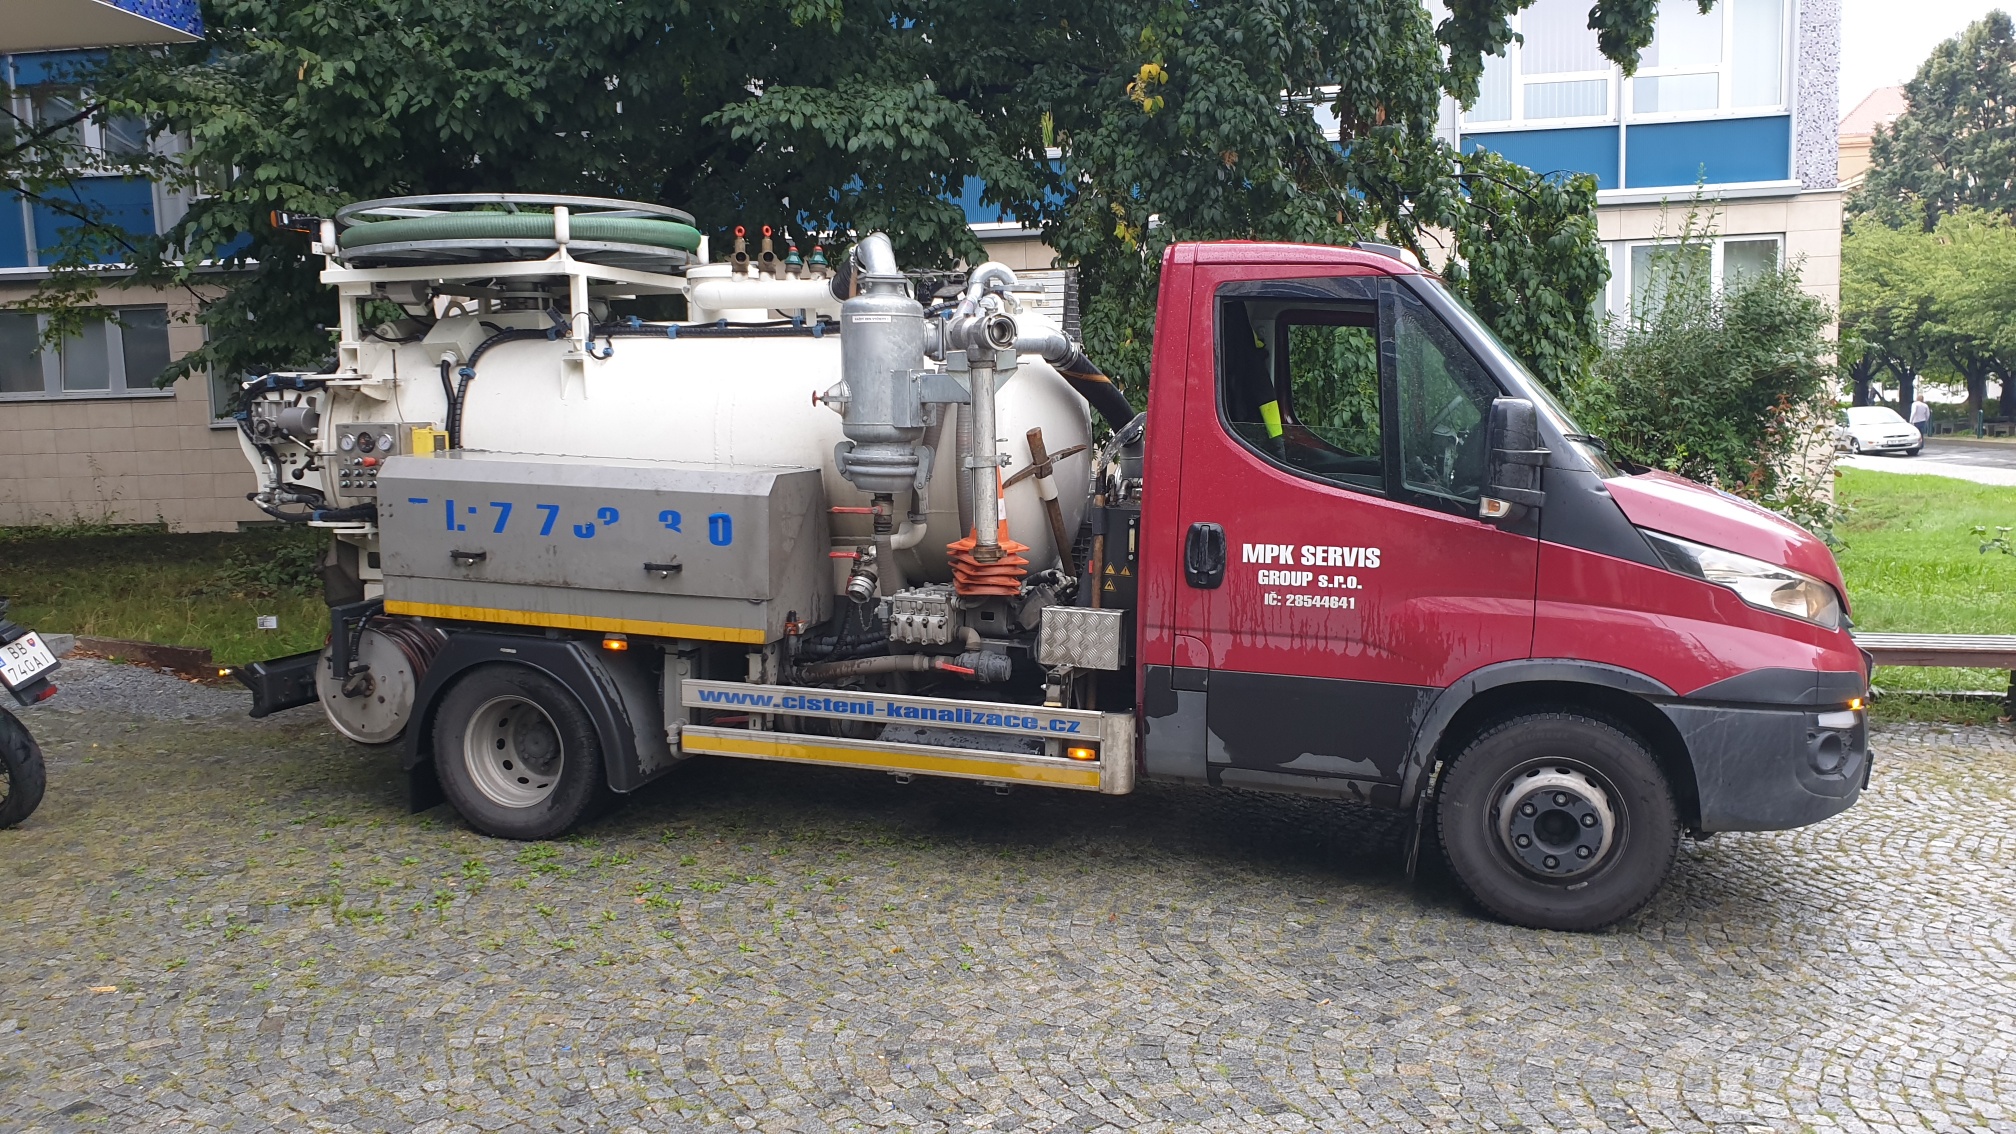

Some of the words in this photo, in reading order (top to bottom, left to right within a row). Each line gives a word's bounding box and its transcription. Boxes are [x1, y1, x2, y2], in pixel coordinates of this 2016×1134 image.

[1242, 543, 1295, 565] MPK
[1300, 545, 1381, 568] SERVIS
[1257, 569, 1313, 587] GROUP
[1317, 574, 1362, 589] s.r.o.
[1264, 591, 1282, 606] IČ:
[1285, 594, 1355, 610] 28544641
[7, 642, 28, 660] BB
[697, 689, 1081, 734] www.cisteni-kanalizace.cz
